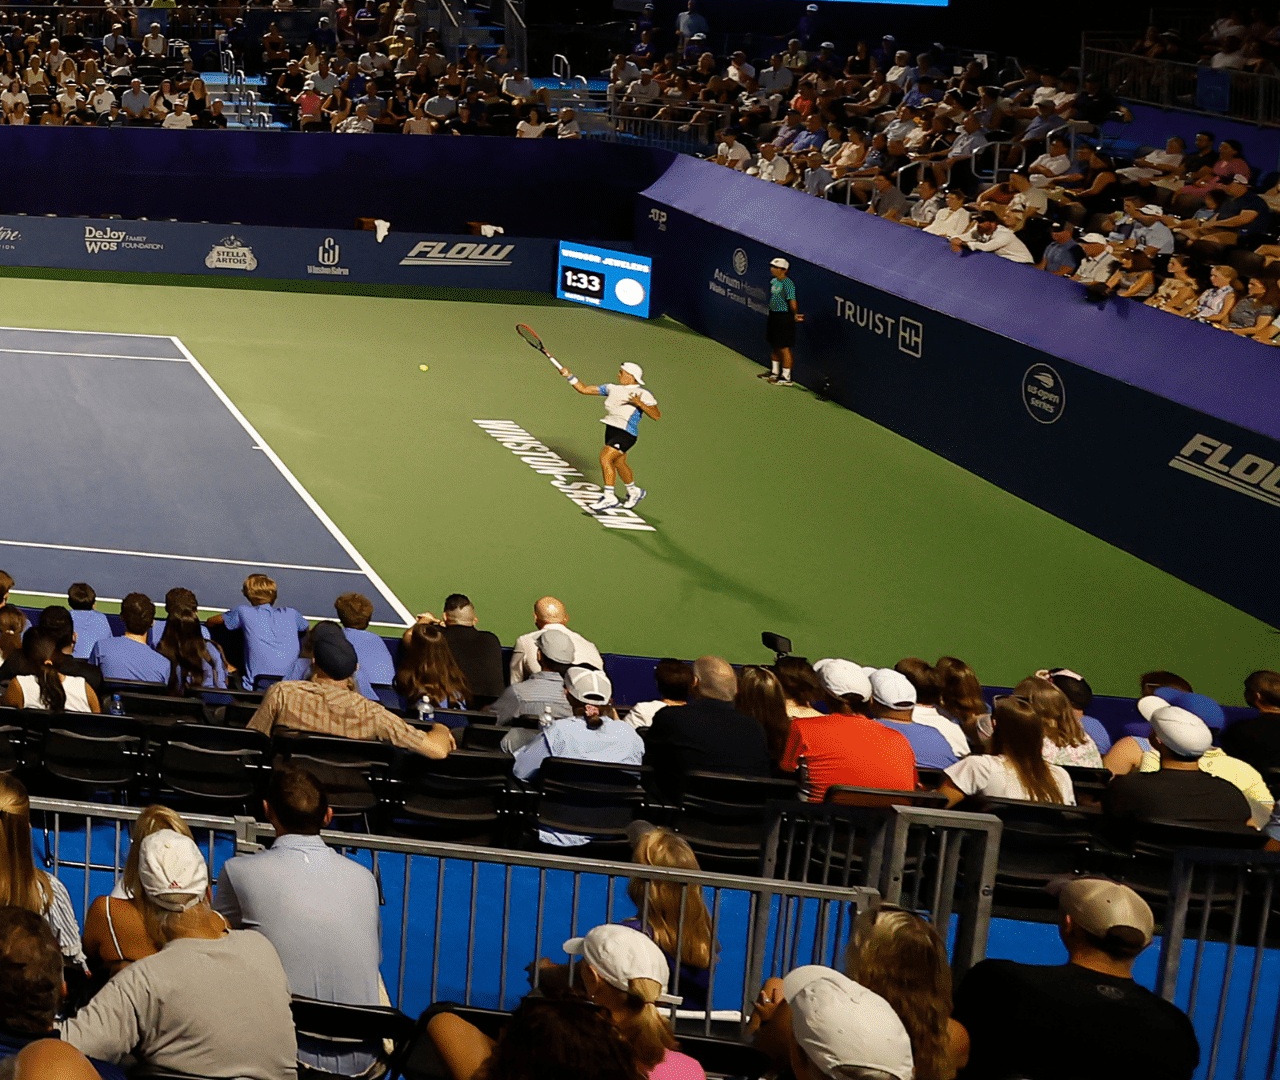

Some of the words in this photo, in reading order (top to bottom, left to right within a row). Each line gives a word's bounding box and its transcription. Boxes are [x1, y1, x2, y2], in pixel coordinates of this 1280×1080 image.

[85, 226, 126, 242] DeJoy
[85, 241, 118, 254] Wos
[121, 242, 164, 250] FOUNDATION
[216, 250, 247, 258] STELLA
[407, 241, 515, 261] FLOW
[215, 257, 247, 265] ARTOIS
[602, 258, 650, 273] JEWELERS
[565, 270, 601, 291] 1:33
[713, 268, 741, 290] Atrium
[834, 295, 895, 338] TRUIST
[1038, 387, 1060, 404] open
[1029, 397, 1055, 414] series
